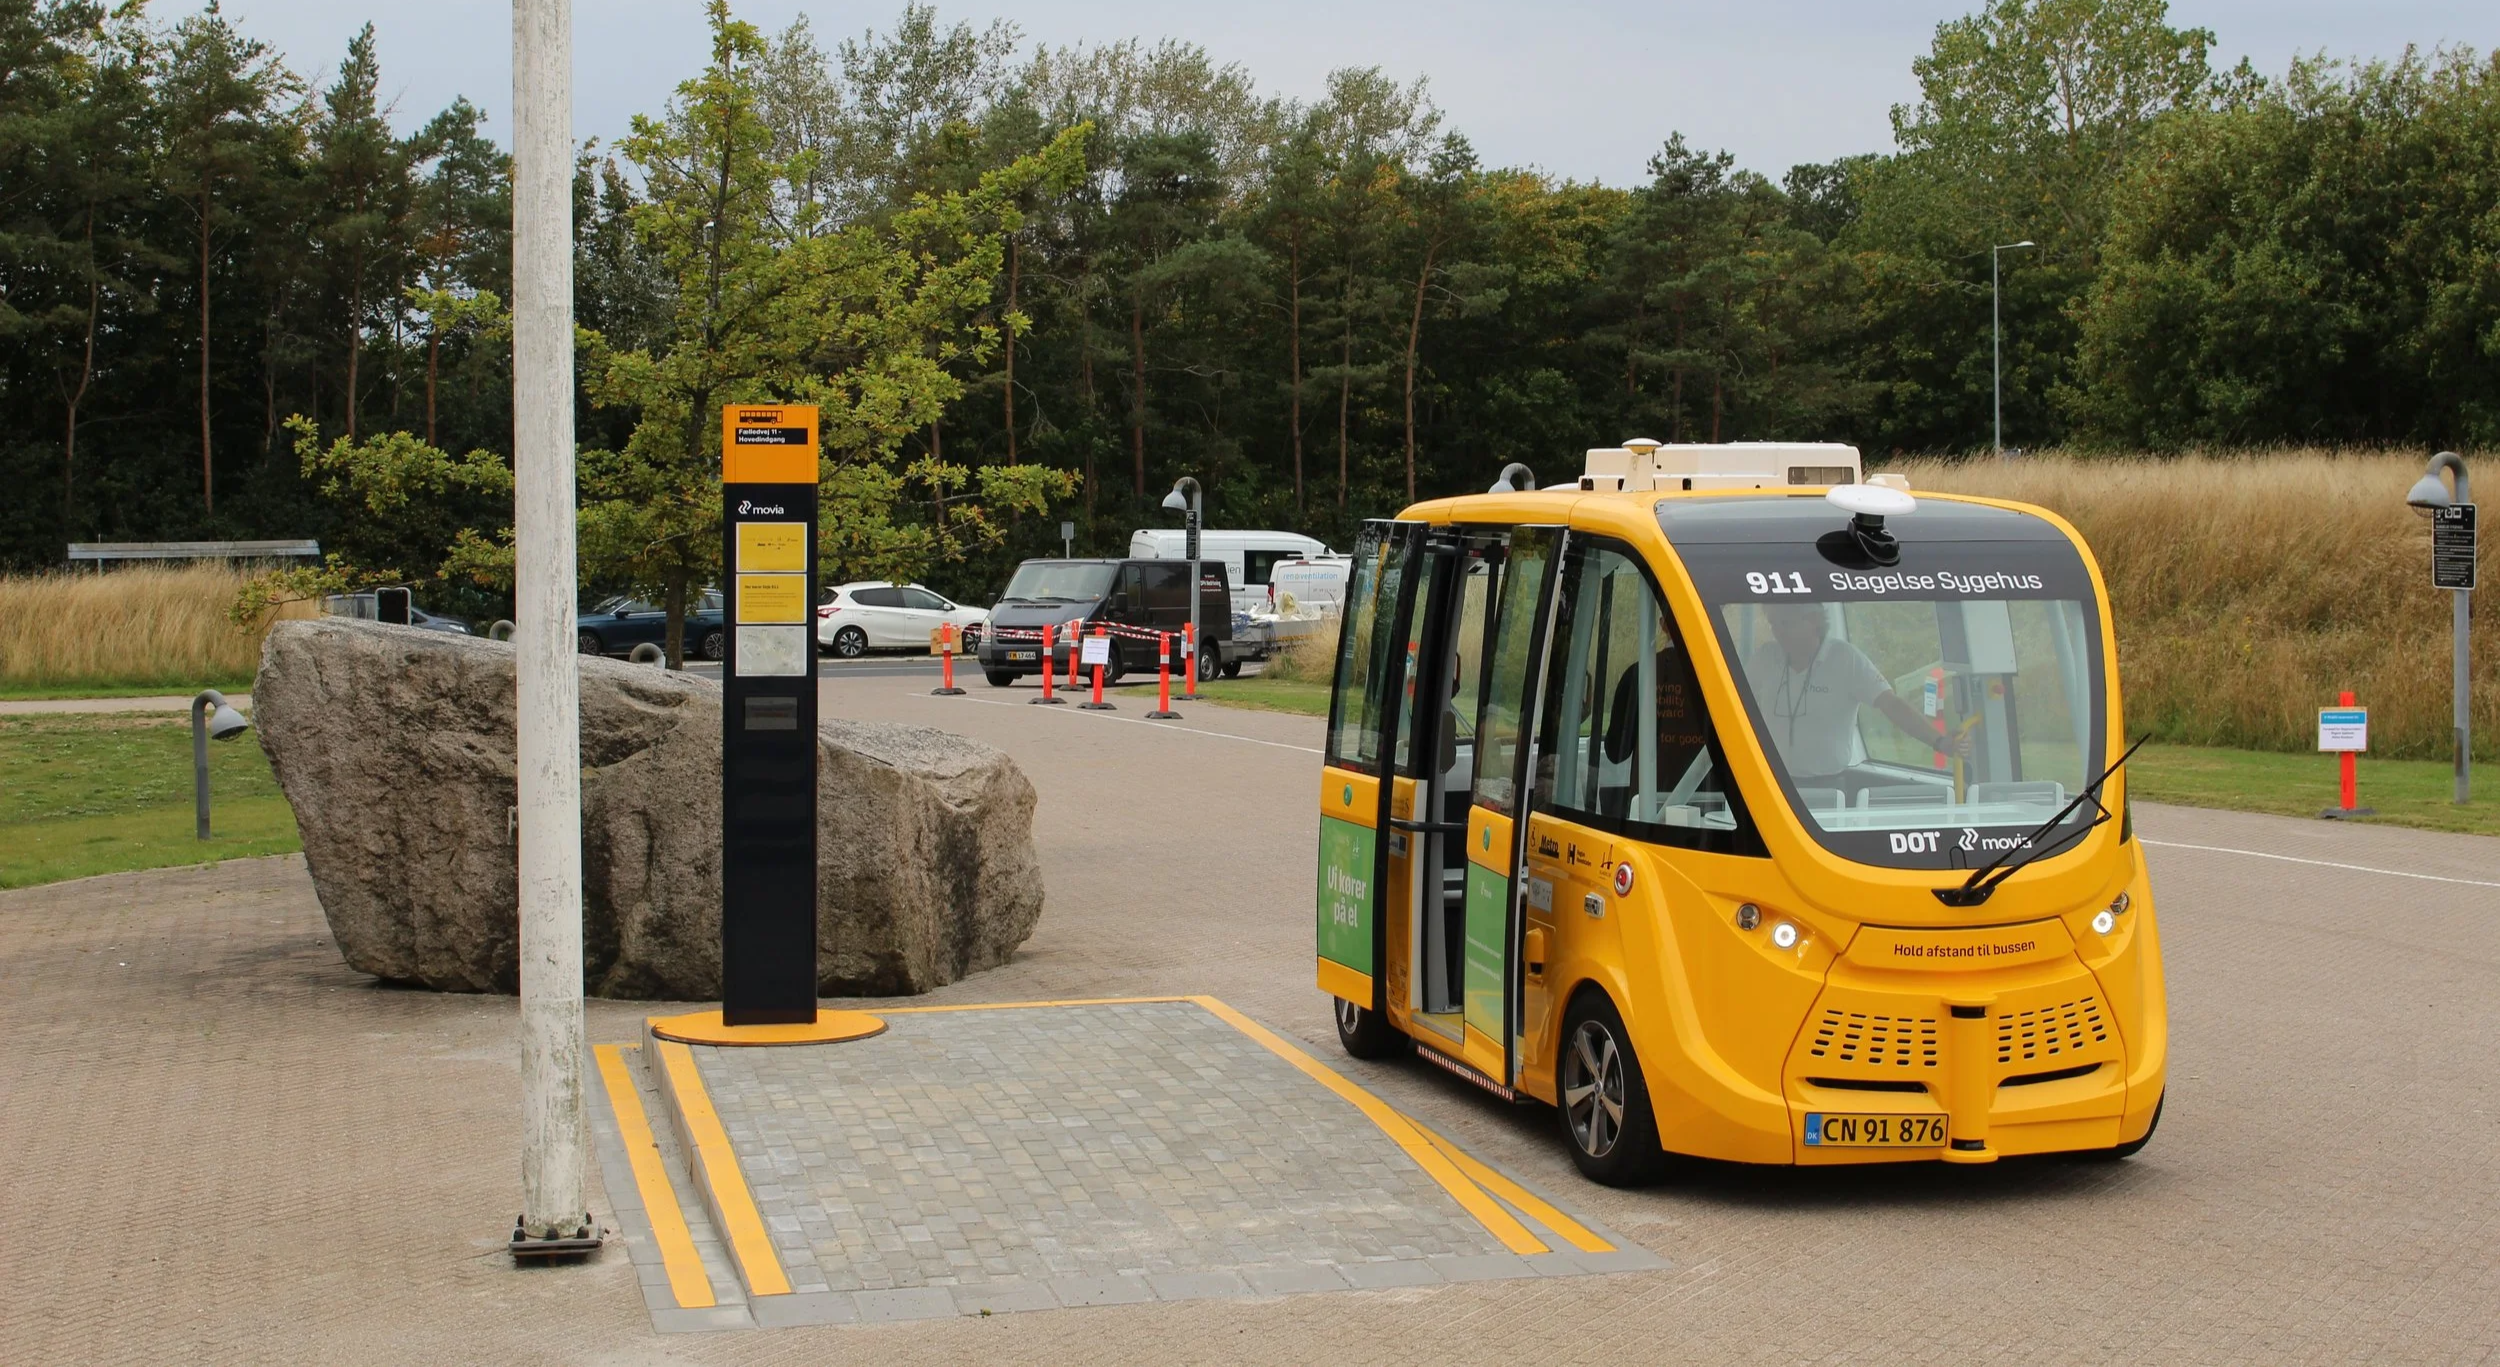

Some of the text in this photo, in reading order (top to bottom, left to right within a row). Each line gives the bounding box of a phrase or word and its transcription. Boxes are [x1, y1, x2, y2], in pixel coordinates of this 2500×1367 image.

[738, 428, 770, 436] Fælledvej
[738, 436, 786, 444] Hovedindgang
[752, 504, 785, 515] movia
[1745, 571, 2043, 595] 911 Slagelse Sygehus
[1541, 835, 1559, 852] Metro
[1889, 831, 1939, 854] DOT
[1982, 833, 2032, 850] movia
[1339, 869, 1367, 900] kører
[1334, 897, 1358, 928] på el
[1894, 940, 2036, 958] Hold afstand til bussen
[1807, 1118, 1944, 1142] DK CN 91 876
